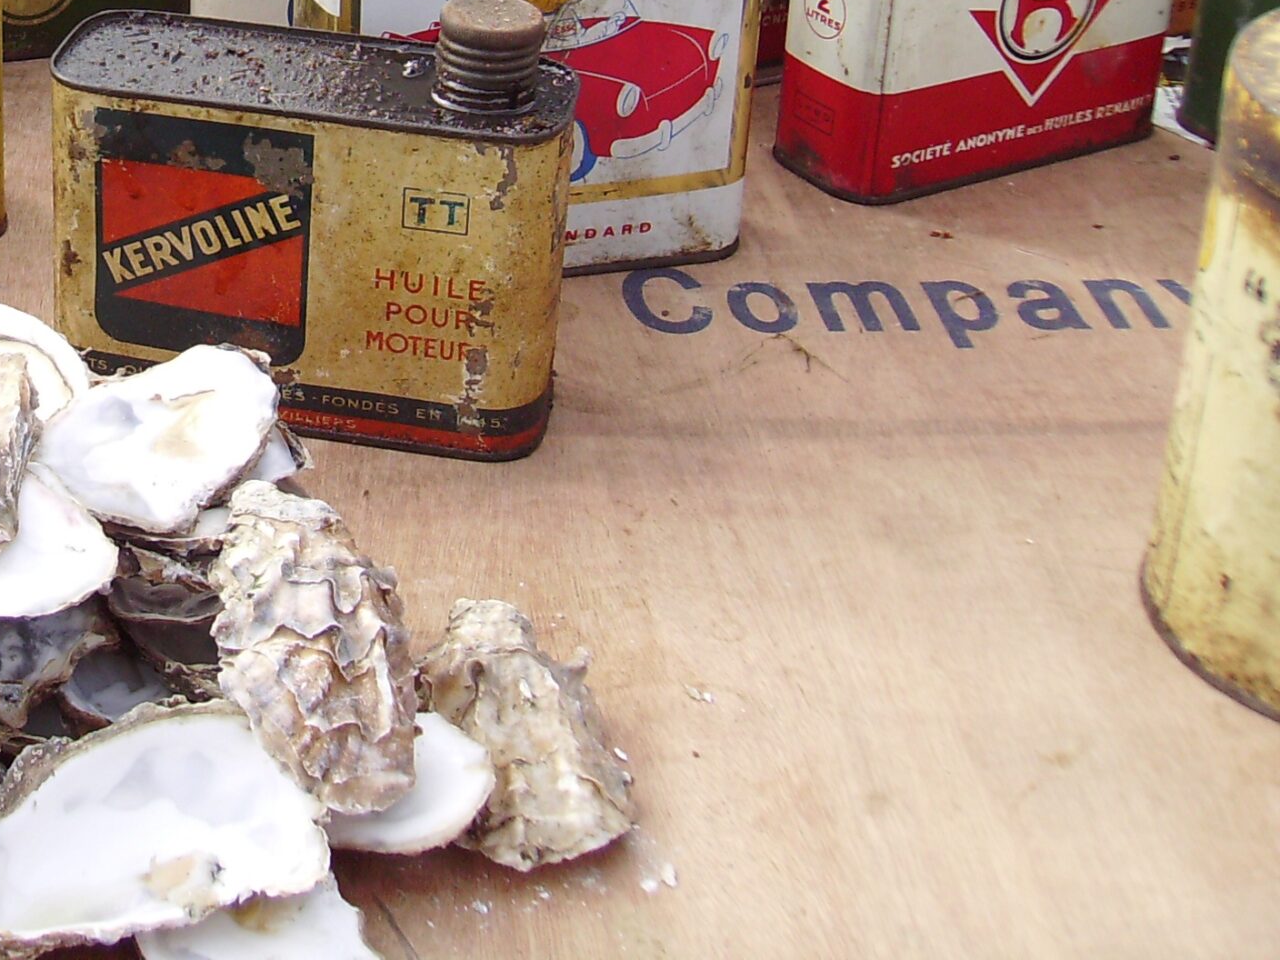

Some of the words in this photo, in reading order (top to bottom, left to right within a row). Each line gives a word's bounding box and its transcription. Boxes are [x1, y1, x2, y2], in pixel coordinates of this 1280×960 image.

[806, 8, 842, 31] LITRES
[890, 140, 952, 169] SOCIÉTÉ
[955, 124, 1026, 153] ANONYME
[1043, 109, 1093, 131] HUILES
[409, 196, 465, 227] TT
[102, 195, 301, 283] KERVOLINE
[565, 221, 653, 241] NDARD
[374, 267, 485, 302] HUILE
[416, 407, 441, 420] EN
